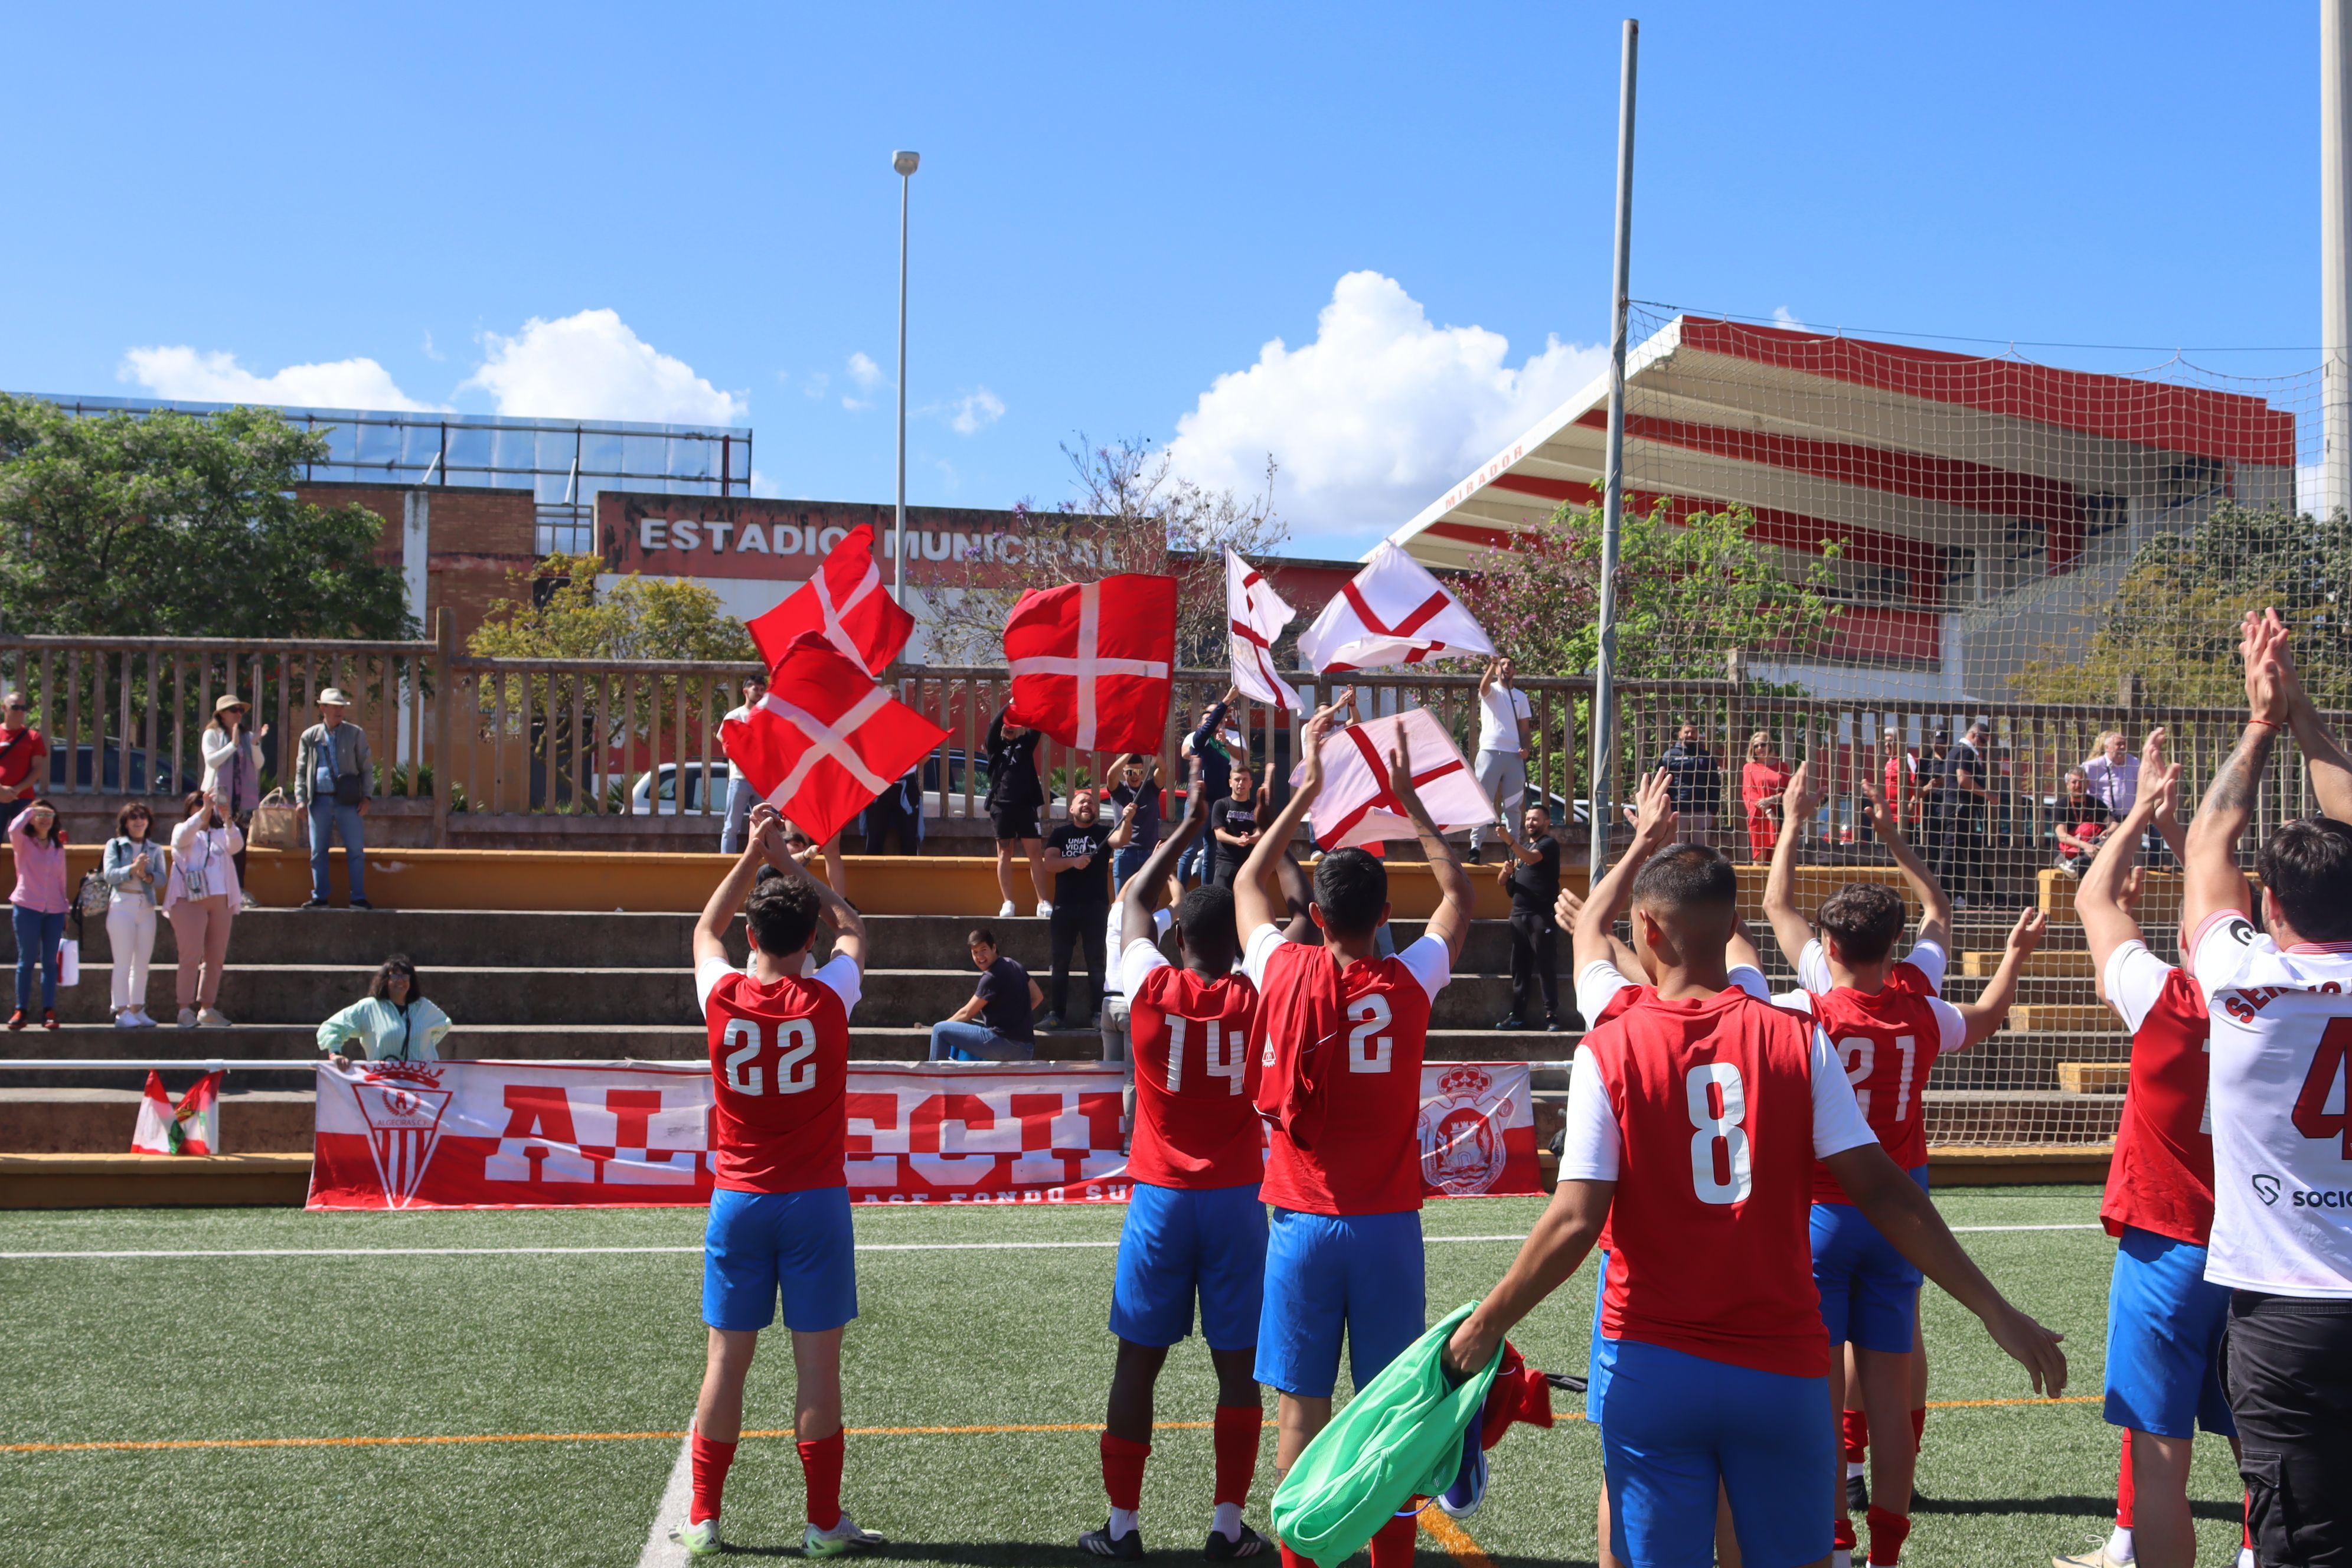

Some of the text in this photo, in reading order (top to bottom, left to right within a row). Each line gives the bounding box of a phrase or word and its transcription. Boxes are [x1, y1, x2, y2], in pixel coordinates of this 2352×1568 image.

[1446, 445, 1523, 510] MIRADOR
[723, 1018, 816, 1096] 22
[1165, 1014, 1244, 1096] 14
[1347, 994, 1392, 1073] 2
[1837, 1035, 1916, 1122] 21
[2291, 1017, 2352, 1160] 4
[1686, 1061, 1752, 1205] 8
[949, 1187, 1065, 1202] FONDO
[1086, 1185, 1127, 1201] SU
